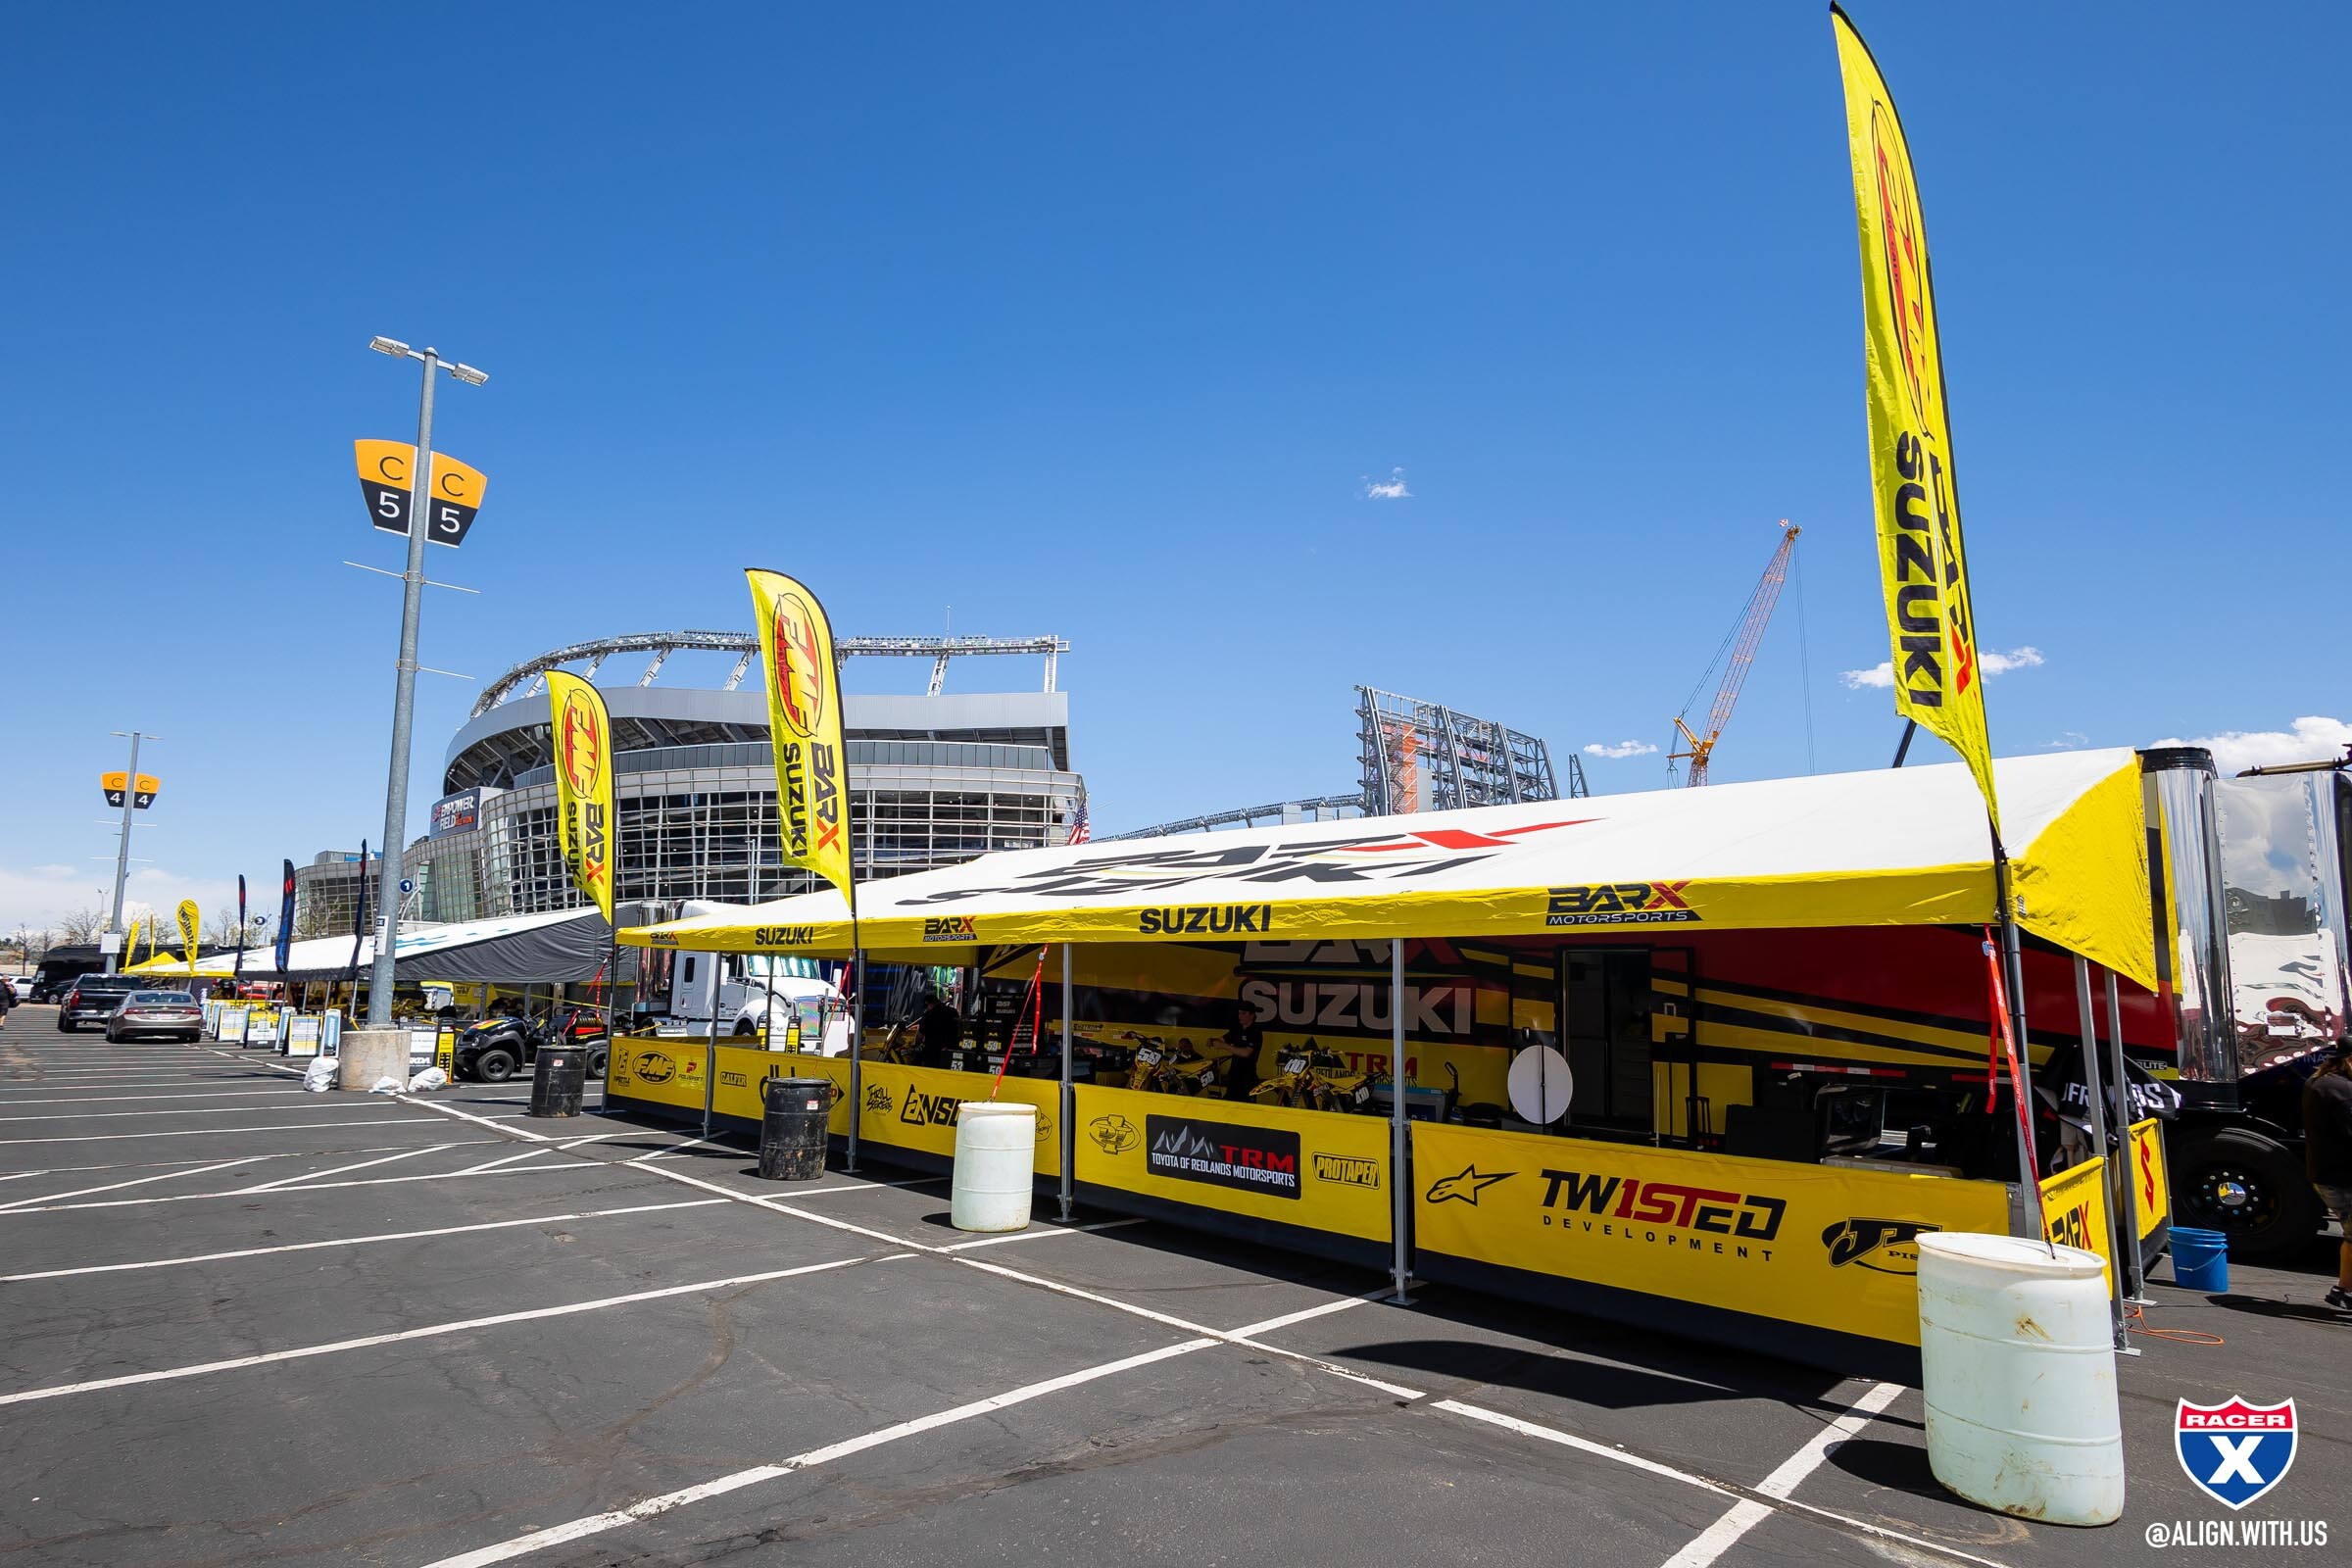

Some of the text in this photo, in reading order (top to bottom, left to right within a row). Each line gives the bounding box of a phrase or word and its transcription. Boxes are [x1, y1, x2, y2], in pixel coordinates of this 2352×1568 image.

[379, 456, 404, 480] C
[441, 472, 465, 497] C
[378, 491, 400, 518] 5
[440, 507, 460, 533] 5
[1895, 430, 1942, 708] SUZUKI
[778, 594, 818, 737] FMF
[569, 690, 596, 799] FMF
[111, 777, 123, 788] C
[139, 780, 151, 791] C
[110, 792, 122, 804] 4
[138, 795, 149, 806] 4
[440, 796, 475, 817] EMPOWER
[783, 743, 808, 858] SUZUKI
[810, 742, 841, 855] BARX
[439, 814, 457, 831] FIELD
[586, 803, 605, 886] BARX
[1547, 880, 1693, 913] BARX
[924, 915, 978, 934] BARX
[1140, 905, 1271, 934] SUZUKI
[1548, 911, 1689, 925] MOTORSPORTS
[755, 926, 814, 946] SUZUKI
[1241, 980, 1472, 1035] SUZUKI
[634, 1056, 674, 1076] FMF
[1152, 1152, 1295, 1188] TOYOTA OF REDLANDS MOTORSPORTS
[1219, 1145, 1294, 1173] TRM
[1316, 1156, 1379, 1187] PROTAPER
[1544, 1215, 1773, 1262] DEVELOPMENT
